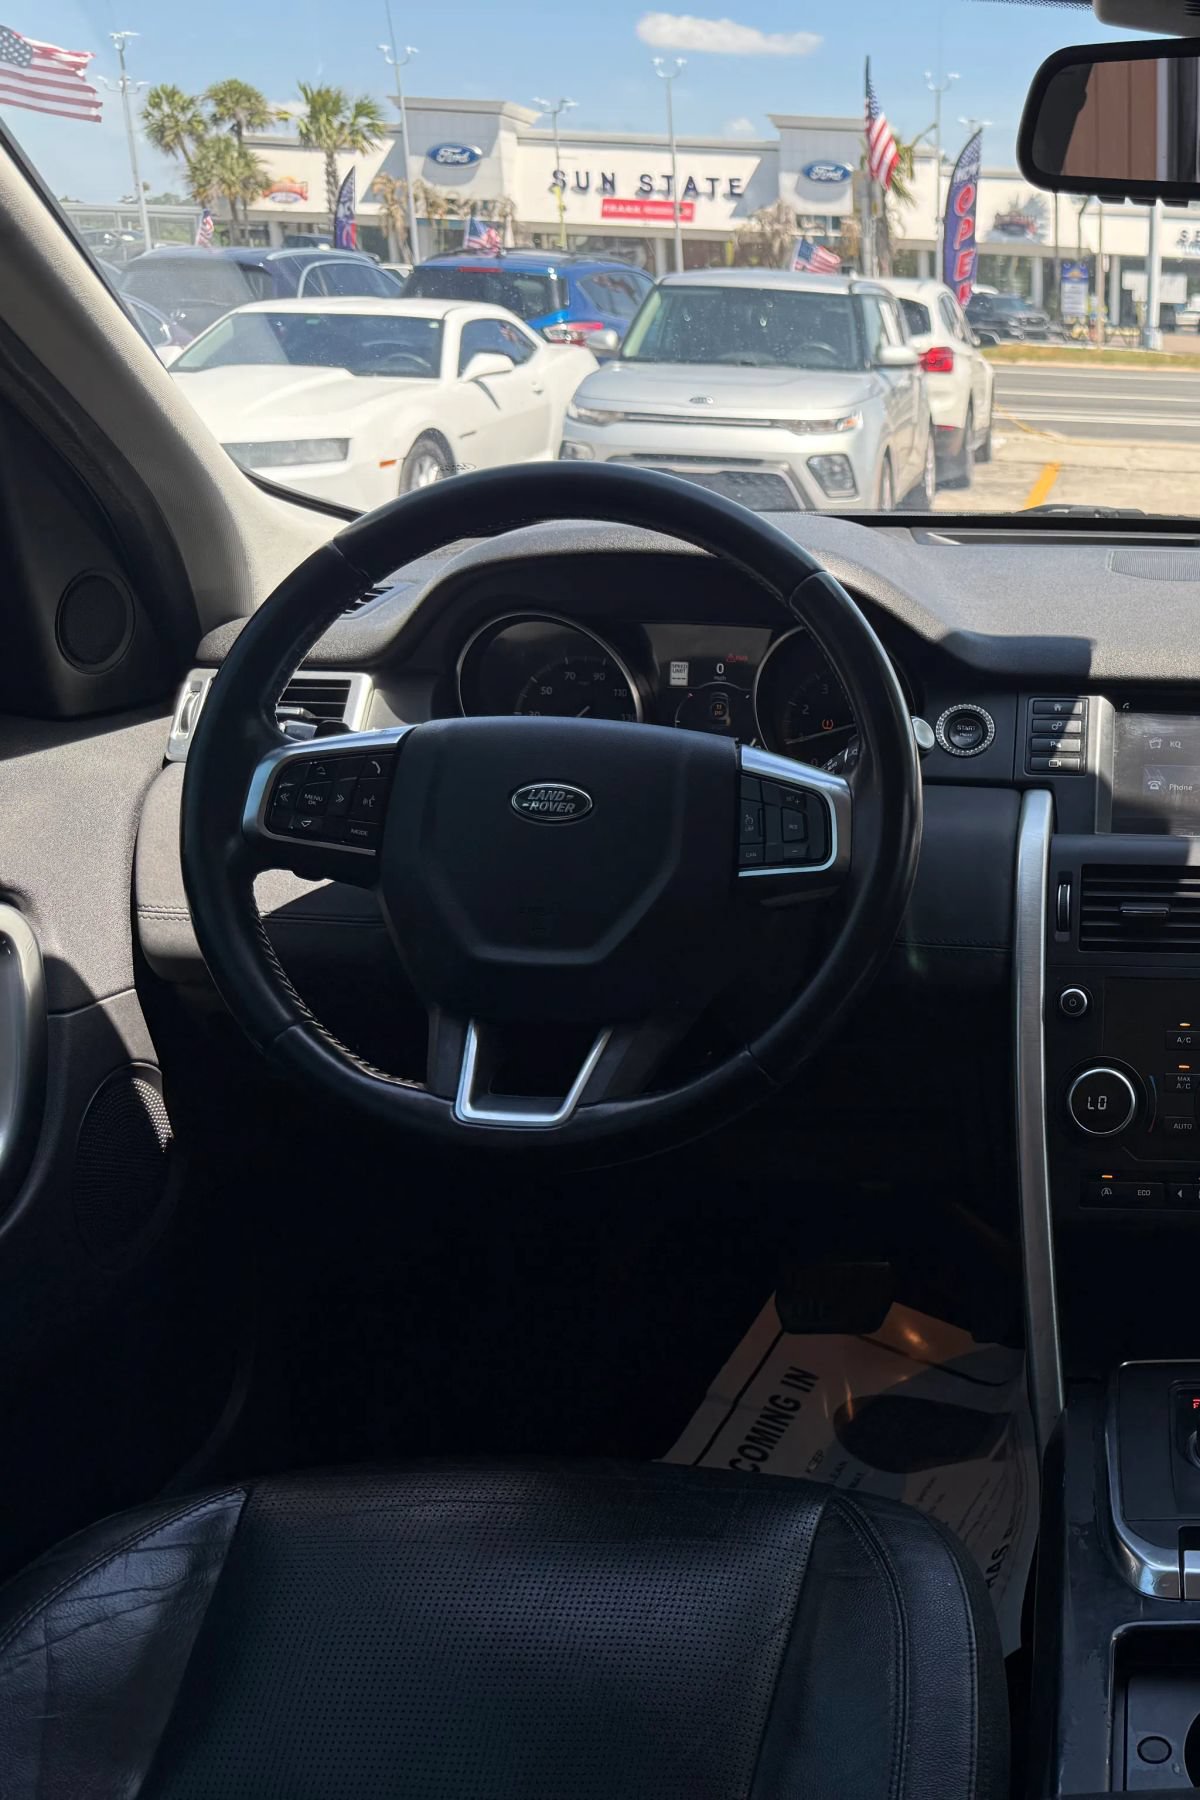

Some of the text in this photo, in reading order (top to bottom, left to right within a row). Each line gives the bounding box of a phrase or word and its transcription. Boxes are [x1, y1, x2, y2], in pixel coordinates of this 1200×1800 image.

[436, 148, 470, 163] Ford
[810, 166, 844, 180] Ford
[552, 169, 744, 198] SUN STATE
[716, 663, 724, 674] 0
[564, 672, 576, 681] 70
[593, 672, 606, 681] 90
[540, 686, 553, 695] 50
[821, 684, 829, 694] 3
[802, 704, 810, 715] 2
[1169, 783, 1193, 791] Phone
[304, 793, 324, 802] MENU
[528, 789, 566, 801] LAND
[529, 801, 575, 813] ROVER
[1137, 1189, 1151, 1197] ECO
[729, 1366, 820, 1472] COMING IN
